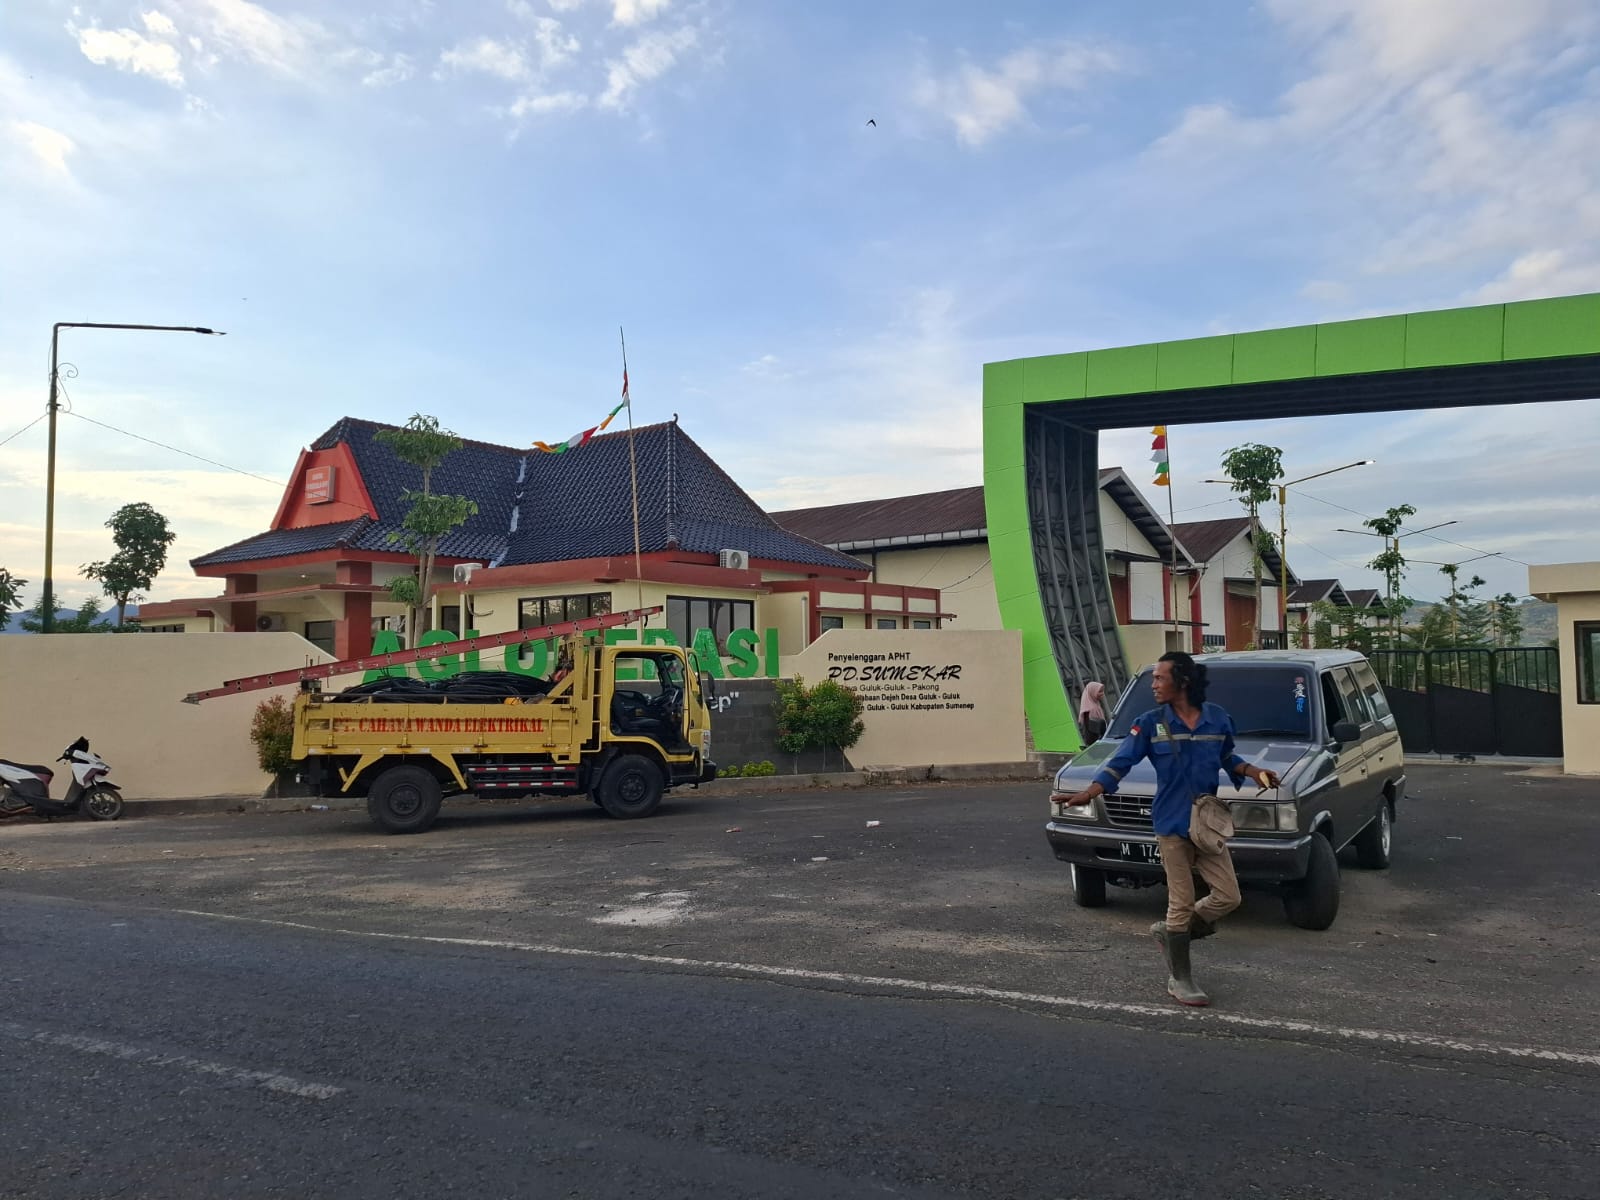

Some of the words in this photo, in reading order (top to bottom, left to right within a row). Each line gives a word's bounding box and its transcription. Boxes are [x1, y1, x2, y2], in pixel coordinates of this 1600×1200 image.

[362, 627, 780, 684] AGLOERASI
[828, 652, 885, 663] Penyelenggara
[888, 652, 910, 661] APHT
[828, 664, 962, 682] PD.SUMEKAR
[859, 684, 905, 692] Guluk-Guluk
[912, 683, 940, 692] Pakong
[901, 693, 917, 701] Desa
[918, 693, 937, 701] Guluk
[942, 692, 960, 700] Guluk
[890, 703, 909, 711] Guluk
[910, 703, 944, 711] Kabupaten
[945, 702, 975, 711] Sumenep
[415, 717, 461, 733] WANDA
[464, 717, 545, 733] ELEKTRIKAL
[1121, 842, 1130, 856] M
[1140, 844, 1160, 857] 174
